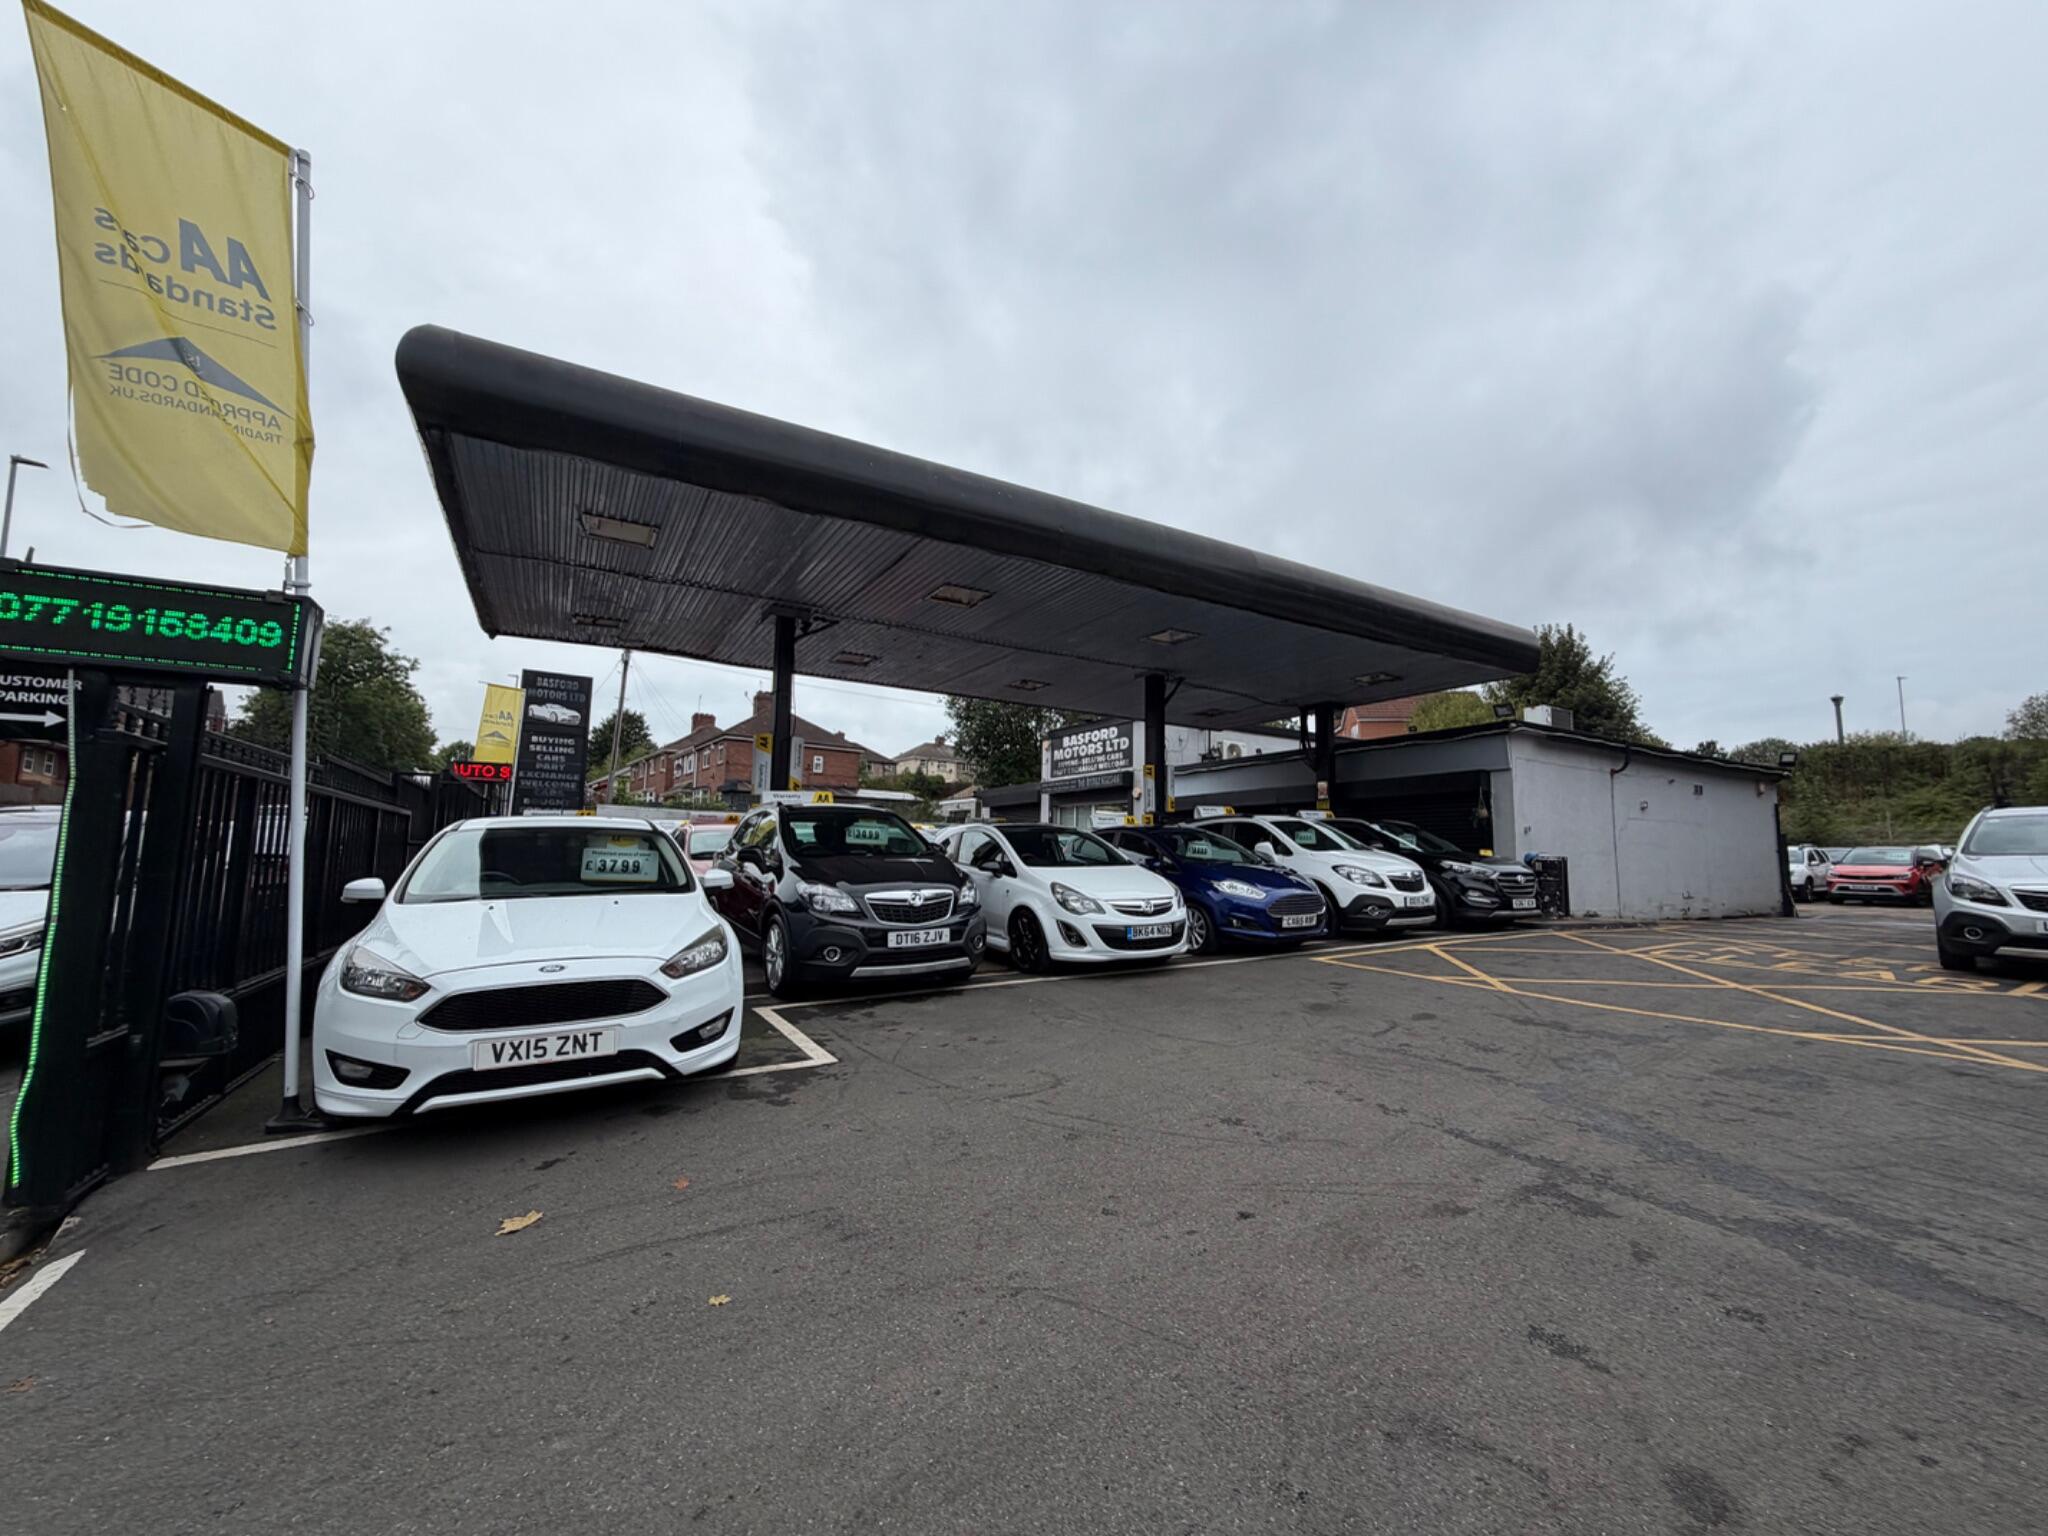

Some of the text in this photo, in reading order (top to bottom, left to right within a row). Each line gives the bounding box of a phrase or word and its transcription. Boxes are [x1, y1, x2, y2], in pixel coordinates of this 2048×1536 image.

[531, 735, 575, 745] BUYING
[1063, 726, 1118, 748] BASFORD
[529, 744, 575, 754] SELLING
[1054, 736, 1130, 760] MOTORS LTD
[536, 753, 566, 763] CARS
[519, 771, 580, 780] EXCHANGE
[816, 794, 831, 804] AA
[598, 859, 640, 873] 3799
[896, 930, 944, 946] DT16 ZJV
[492, 1032, 603, 1063] VX15 ZNT
